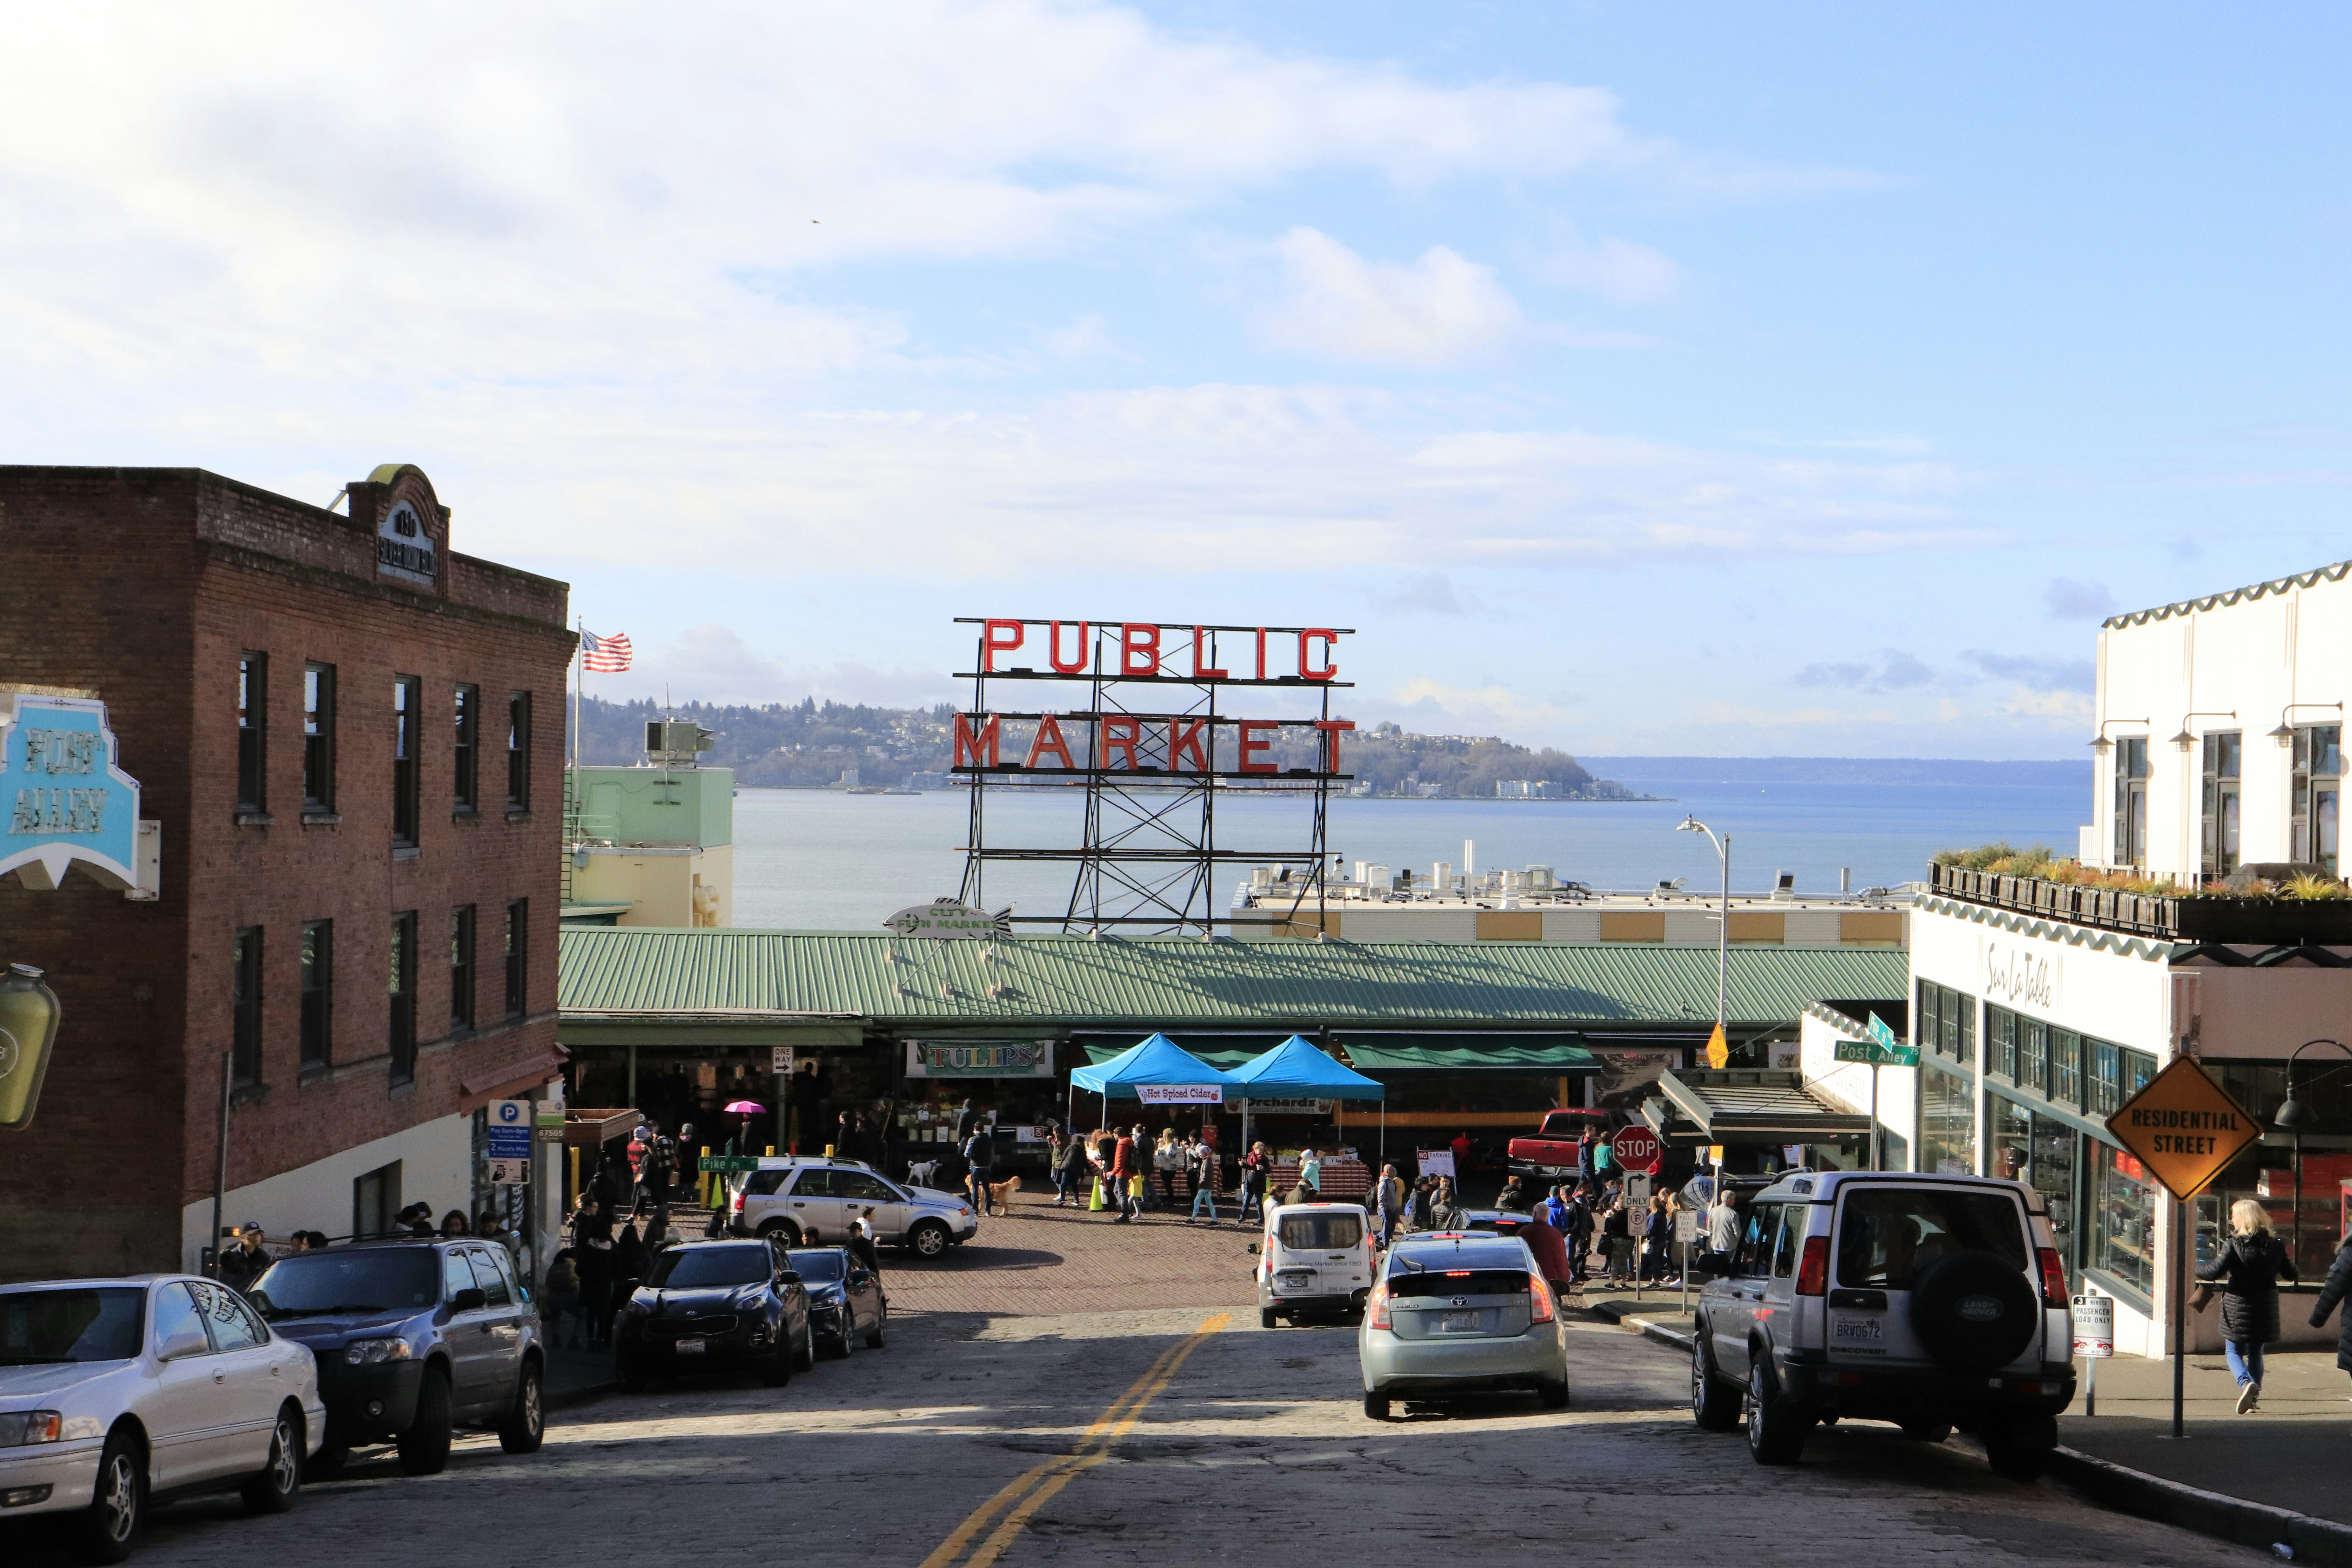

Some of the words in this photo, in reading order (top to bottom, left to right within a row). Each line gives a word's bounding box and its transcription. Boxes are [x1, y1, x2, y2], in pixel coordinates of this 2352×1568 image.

[983, 619, 1338, 680] PUBLIC
[24, 728, 100, 775] POST
[954, 712, 1356, 773] MARKET
[8, 788, 109, 835] ALLEY
[929, 908, 968, 916] CITY
[897, 920, 931, 928] FISH
[937, 920, 998, 929] MARKET
[1986, 942, 2008, 995] Sur
[2009, 949, 2024, 1001] La
[2025, 952, 2052, 1009] Table
[1870, 1015, 1880, 1037] Pine
[929, 1046, 1033, 1068] TULIPS
[1838, 1042, 1871, 1060] Post
[1878, 1050, 1907, 1064] Alley
[1910, 1047, 1919, 1056] 75
[1147, 1089, 1160, 1098] Hot
[1162, 1088, 1188, 1101] Spiced
[1190, 1088, 1211, 1098] Cider
[2132, 1109, 2239, 1131] RESIDENTIAL
[1035, 1127, 1041, 1136] NO
[1617, 1140, 1656, 1157] STOP
[2153, 1135, 2216, 1154] STREET
[703, 1158, 725, 1169] Pike
[1830, 1347, 1887, 1355] DISCOVERY
